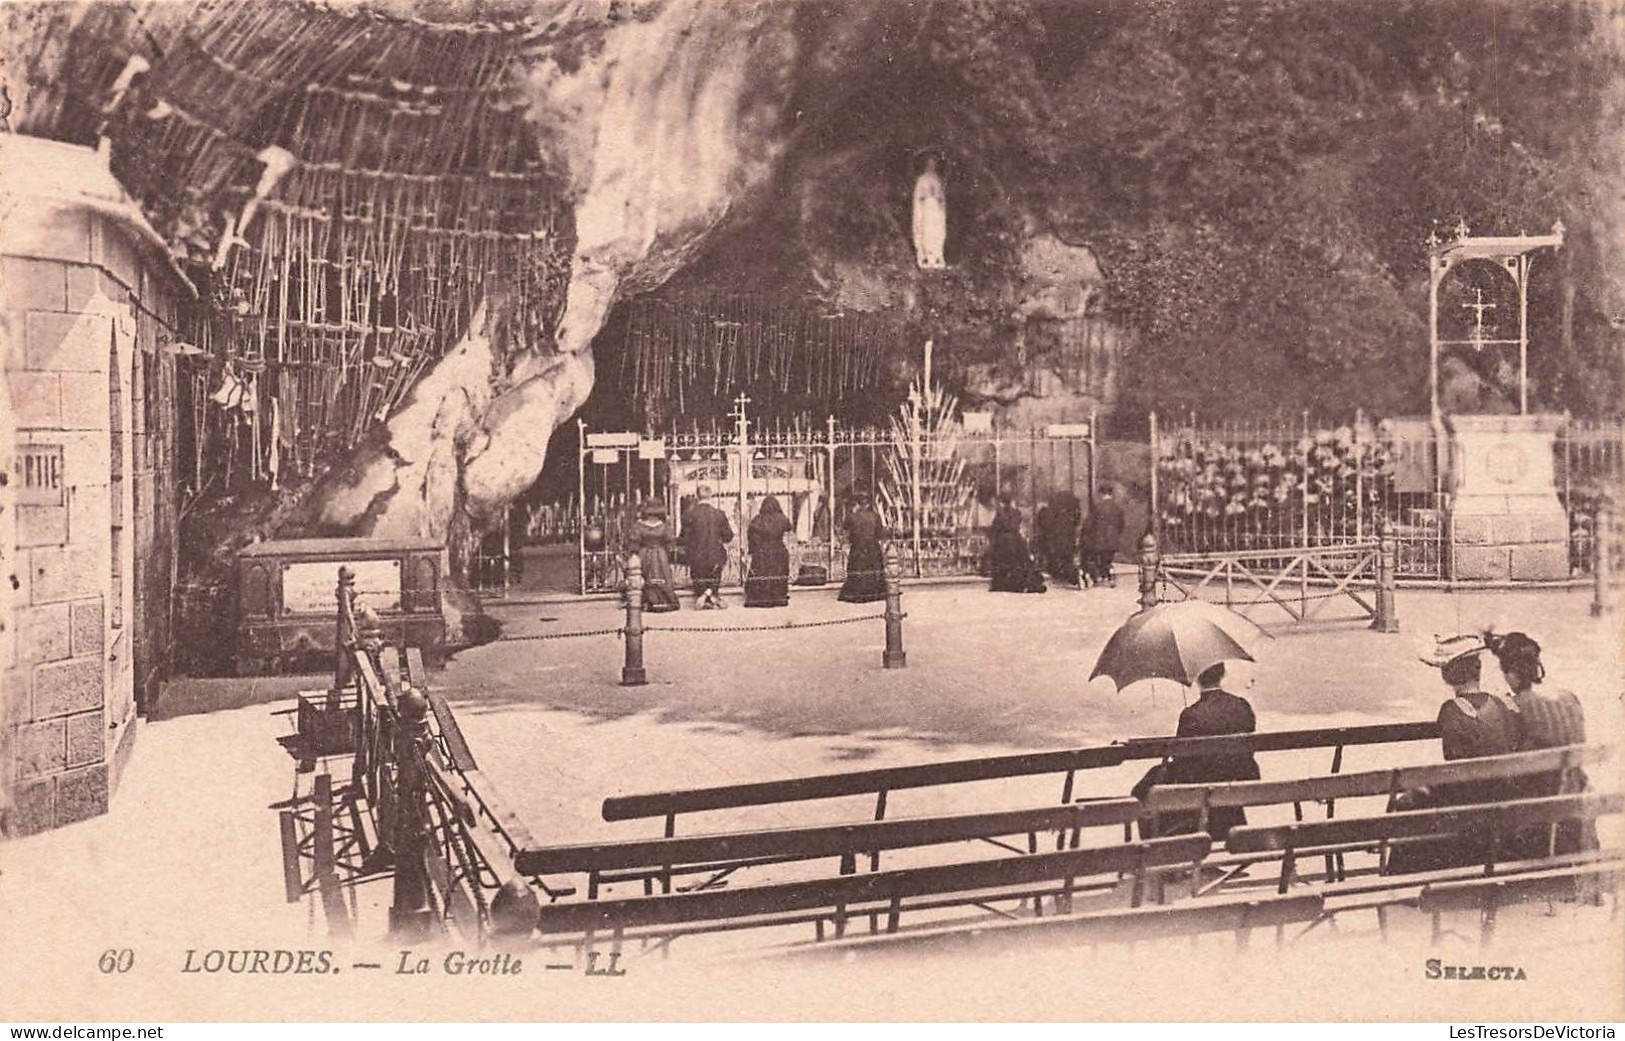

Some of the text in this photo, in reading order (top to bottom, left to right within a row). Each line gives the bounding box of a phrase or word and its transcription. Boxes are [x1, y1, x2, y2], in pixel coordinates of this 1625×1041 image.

[99, 949, 134, 974] 60
[181, 949, 340, 974] LOURDES.
[395, 950, 430, 975] La
[443, 951, 522, 975] Grotte
[584, 951, 627, 977] LL
